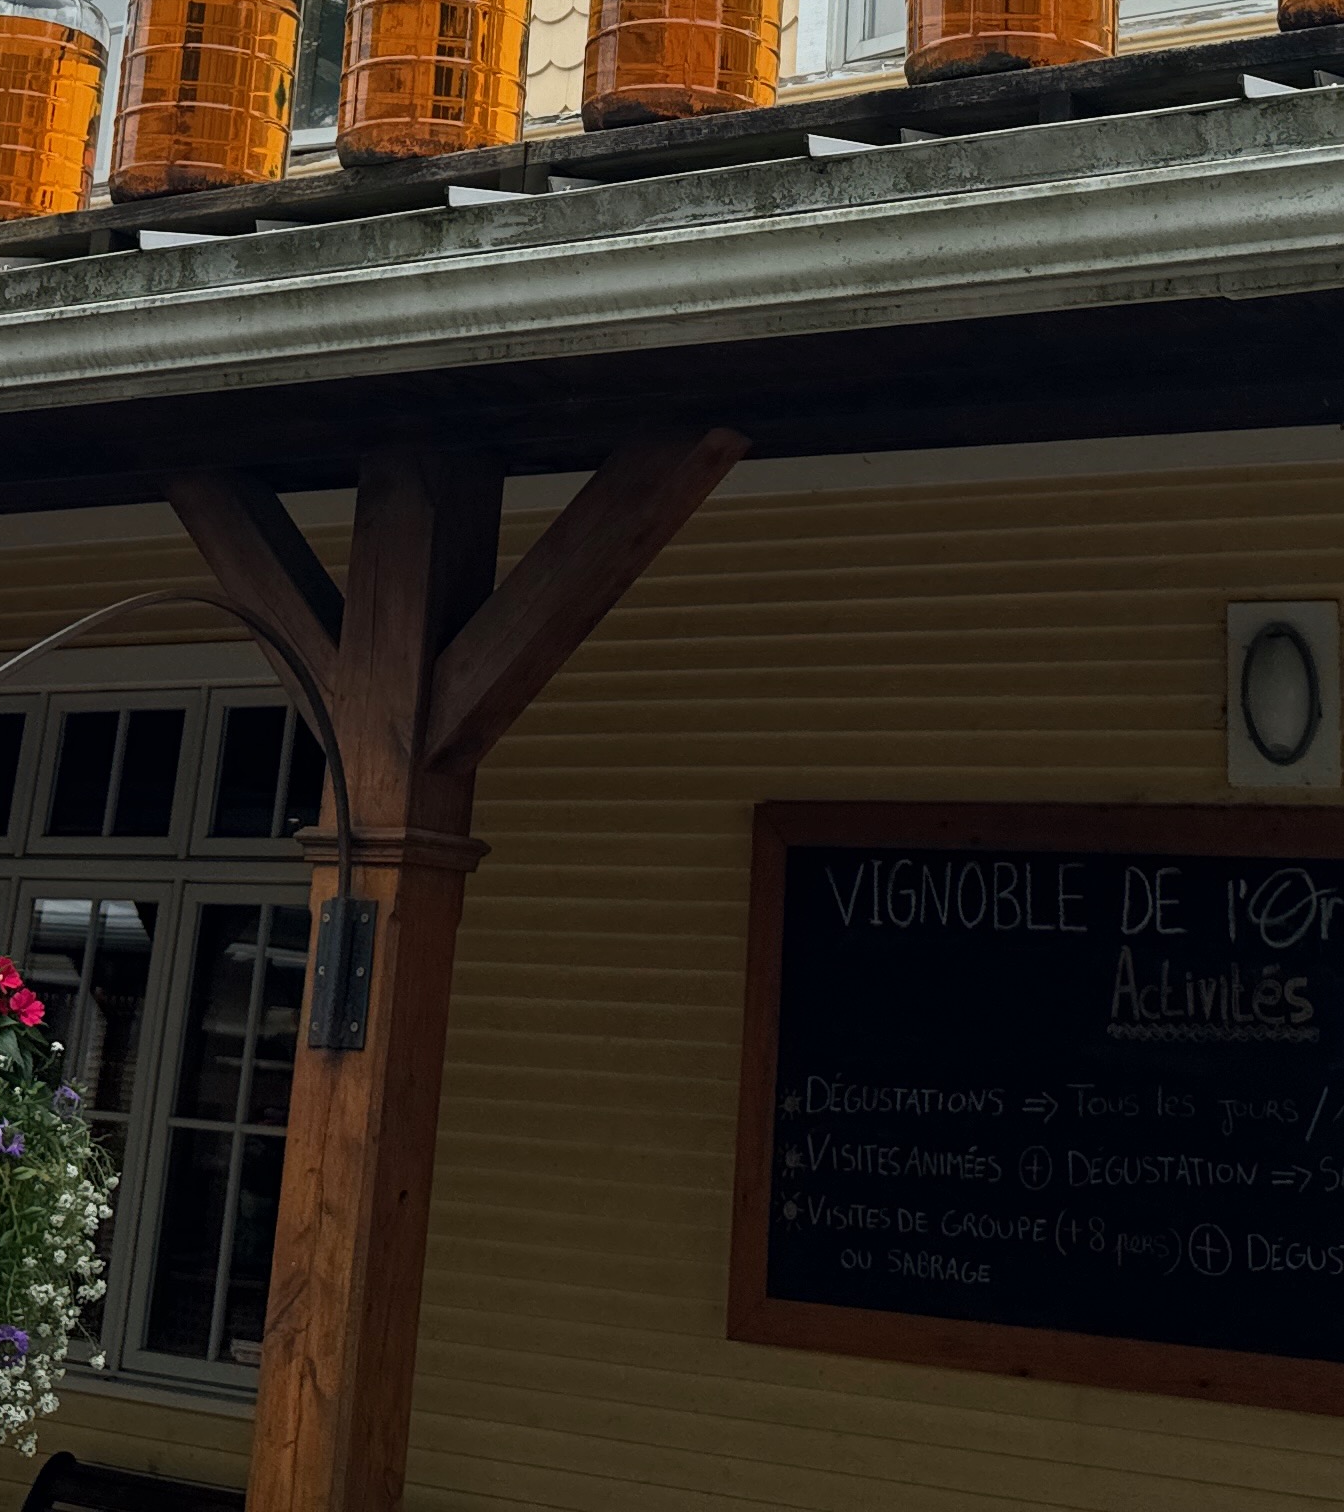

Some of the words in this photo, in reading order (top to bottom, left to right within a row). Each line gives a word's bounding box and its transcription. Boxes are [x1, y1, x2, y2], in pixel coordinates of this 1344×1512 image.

[825, 859, 1089, 931] VIGNOBLE
[1121, 866, 1187, 934] DE
[1111, 945, 1315, 1027] Activités
[806, 1072, 1006, 1117] DÉGUSTATIONS
[807, 1133, 901, 1177] VISITES
[1067, 1146, 1259, 1187] DÉGUSTATION
[807, 1195, 891, 1233] VISITES
[897, 1206, 929, 1234] DE
[941, 1209, 1049, 1243] GROUPE
[887, 1249, 992, 1284] SABRAGE
